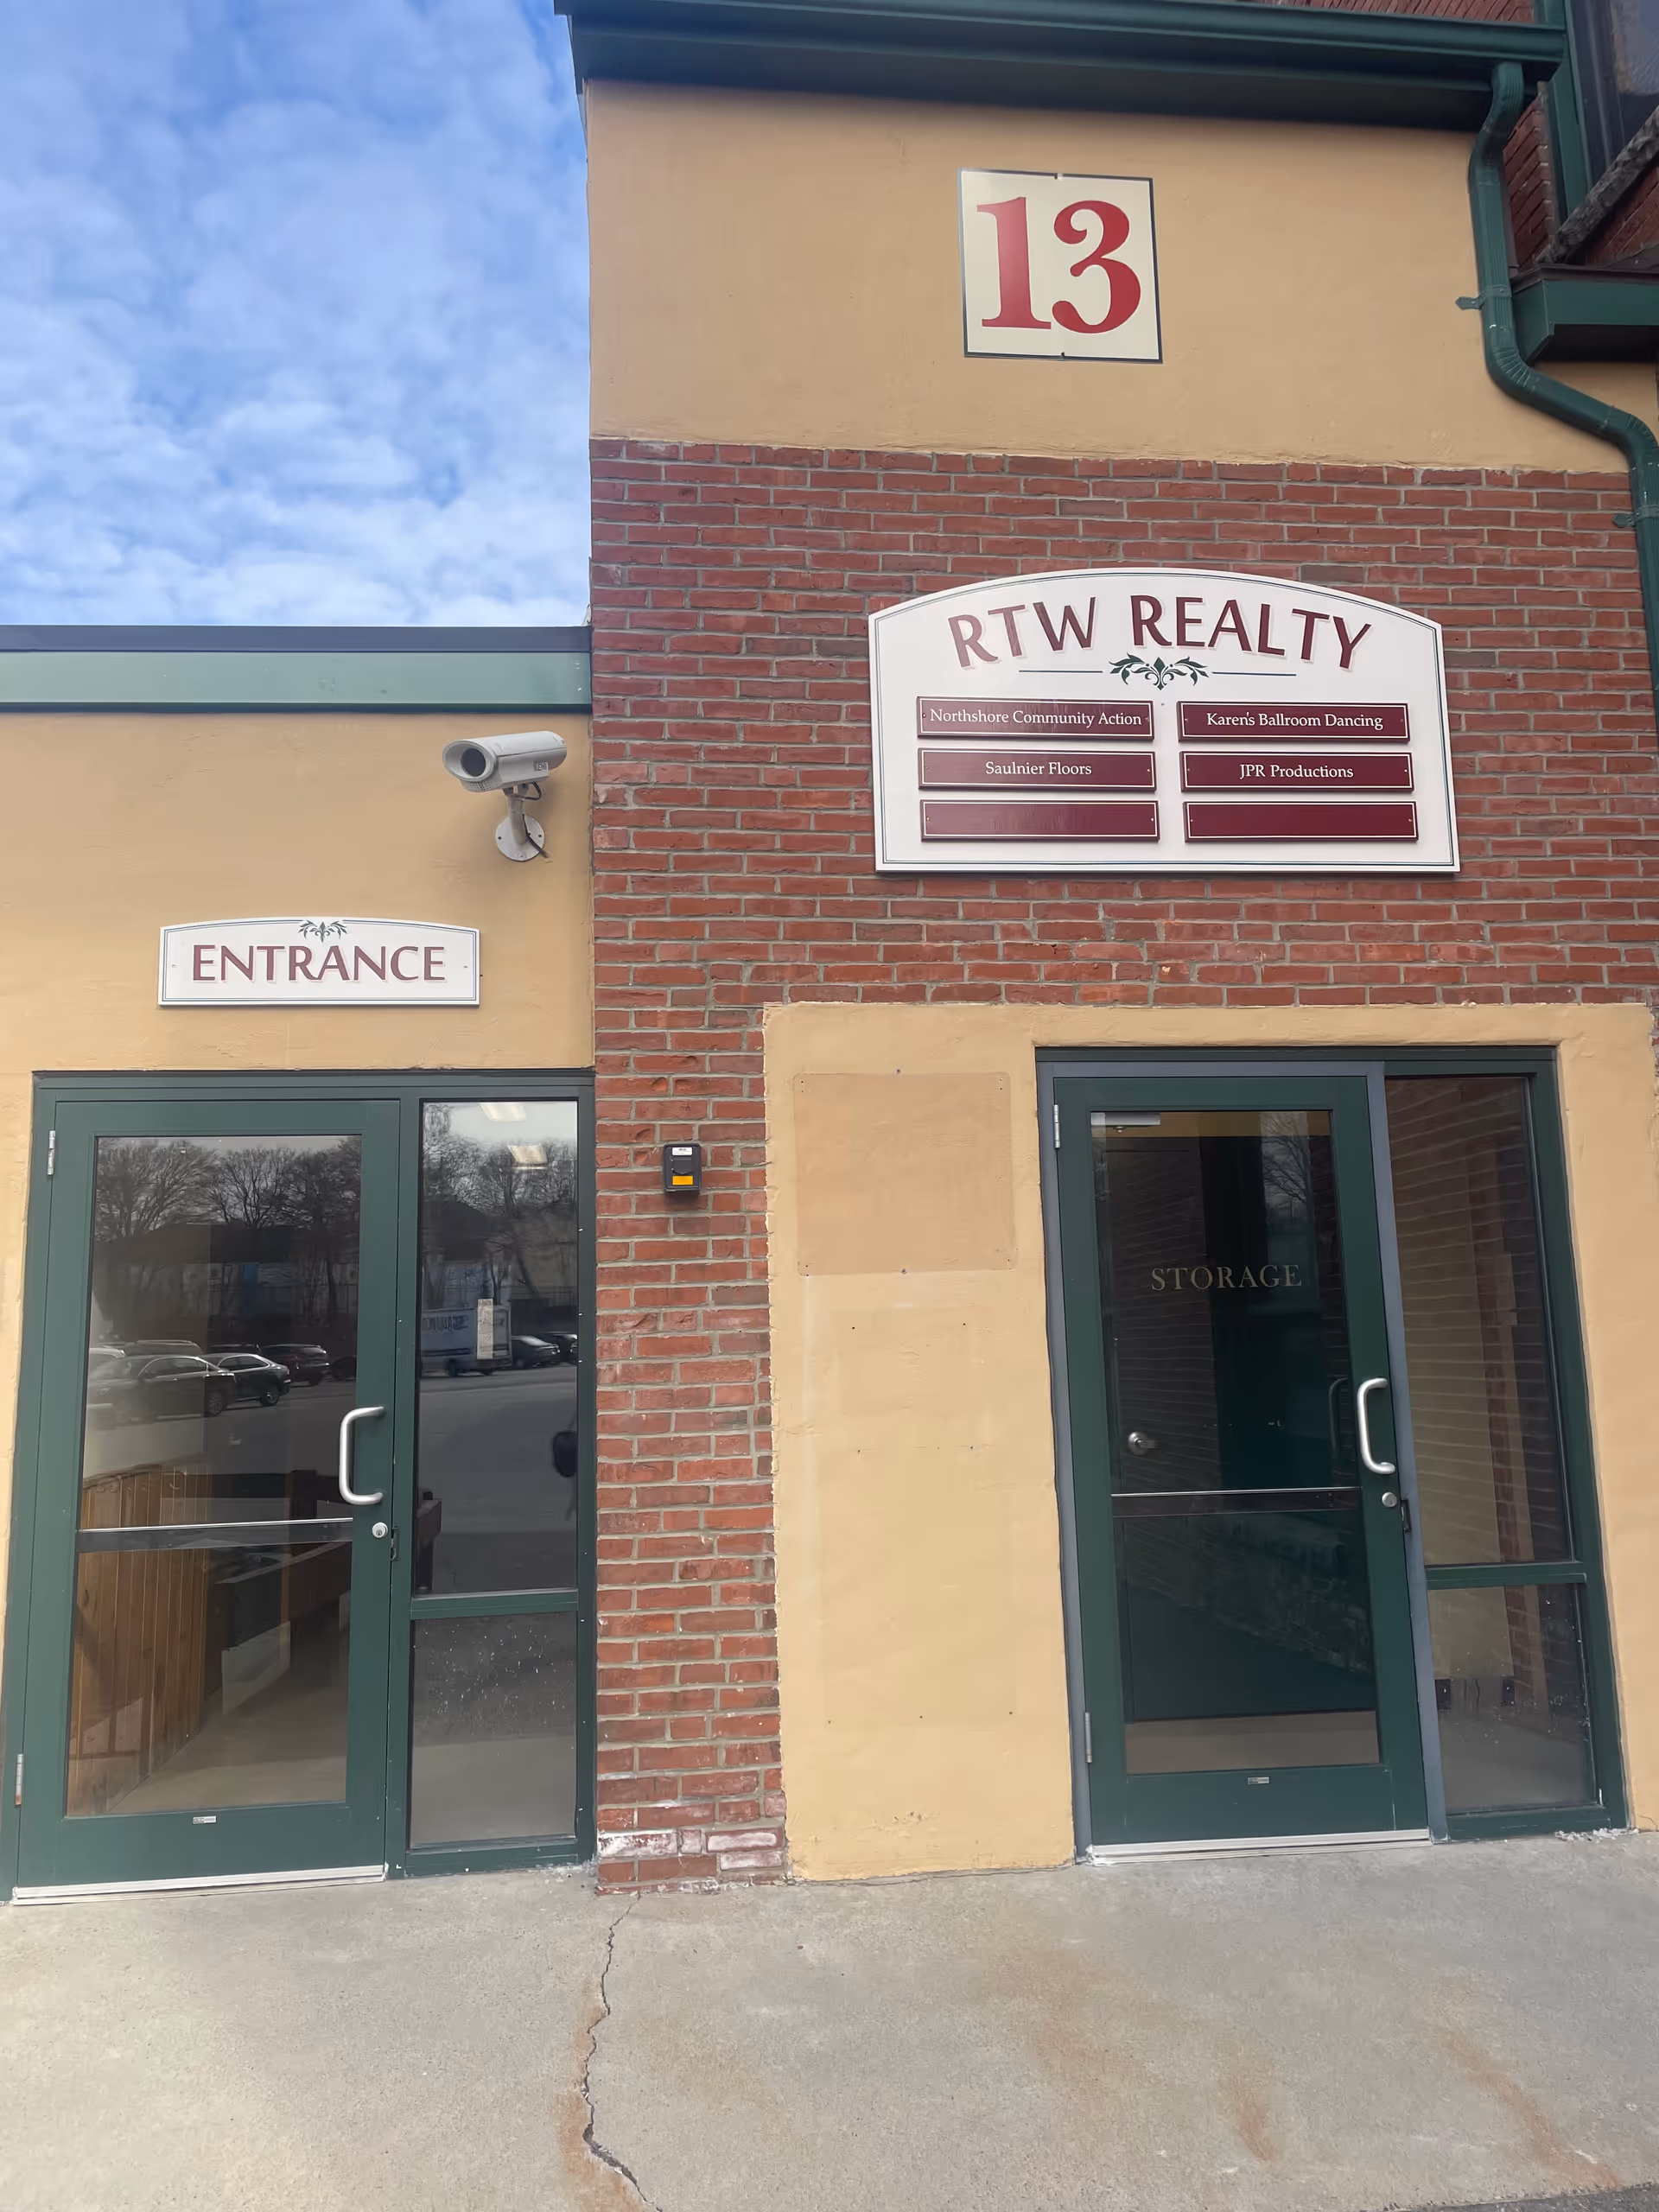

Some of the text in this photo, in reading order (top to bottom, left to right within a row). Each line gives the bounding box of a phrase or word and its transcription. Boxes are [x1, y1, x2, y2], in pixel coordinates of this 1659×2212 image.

[976, 196, 1141, 334] 13
[949, 594, 1372, 670] RTW REALTY
[930, 709, 1142, 728] Northshore Community Action
[1206, 711, 1383, 730] Karen's Ballroom Dancing
[985, 761, 1092, 775] Saulnier Floors
[1239, 764, 1354, 779] JPR Productions
[192, 944, 446, 982] ENTRANCE
[1151, 1264, 1302, 1292] STORAGE
